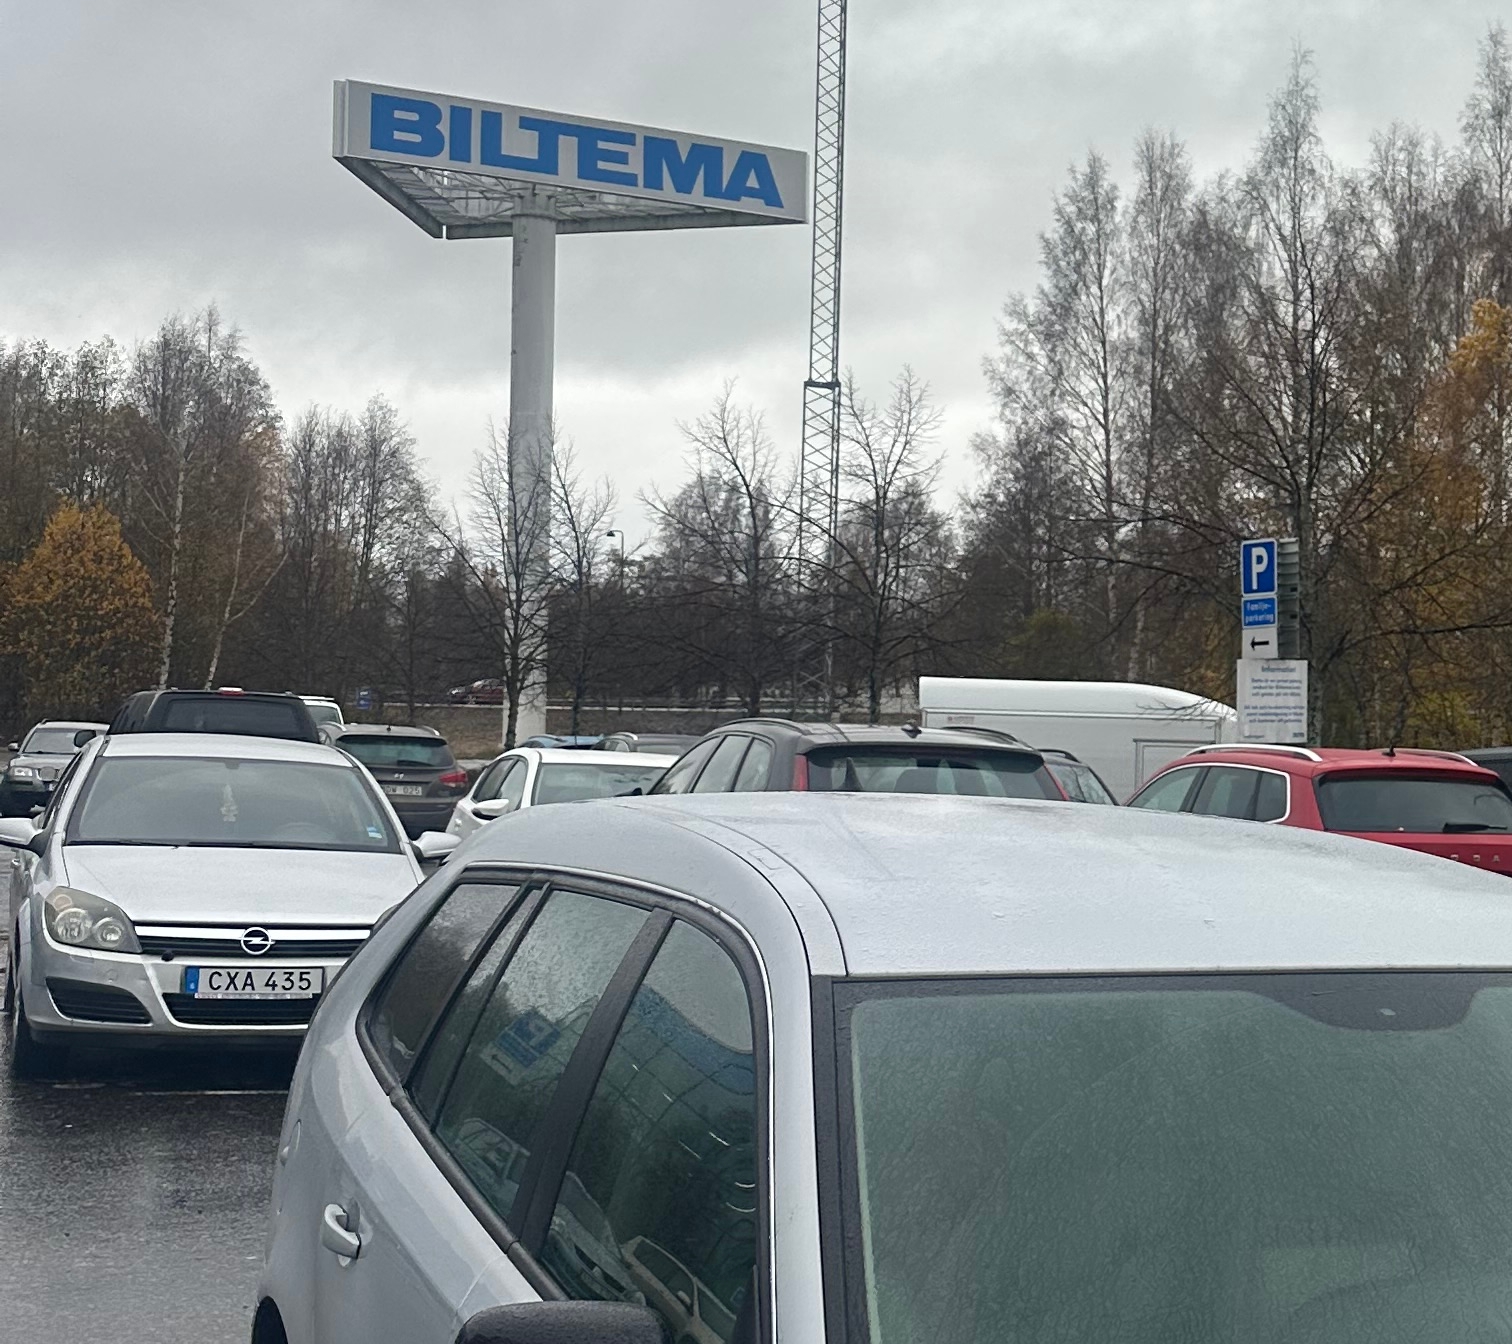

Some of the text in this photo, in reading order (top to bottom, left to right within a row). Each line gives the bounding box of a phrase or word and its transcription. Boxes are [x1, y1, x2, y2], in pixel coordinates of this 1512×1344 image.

[370, 92, 784, 209] BILTEMA
[1251, 546, 1269, 590] P
[208, 970, 312, 992] CXA 435
